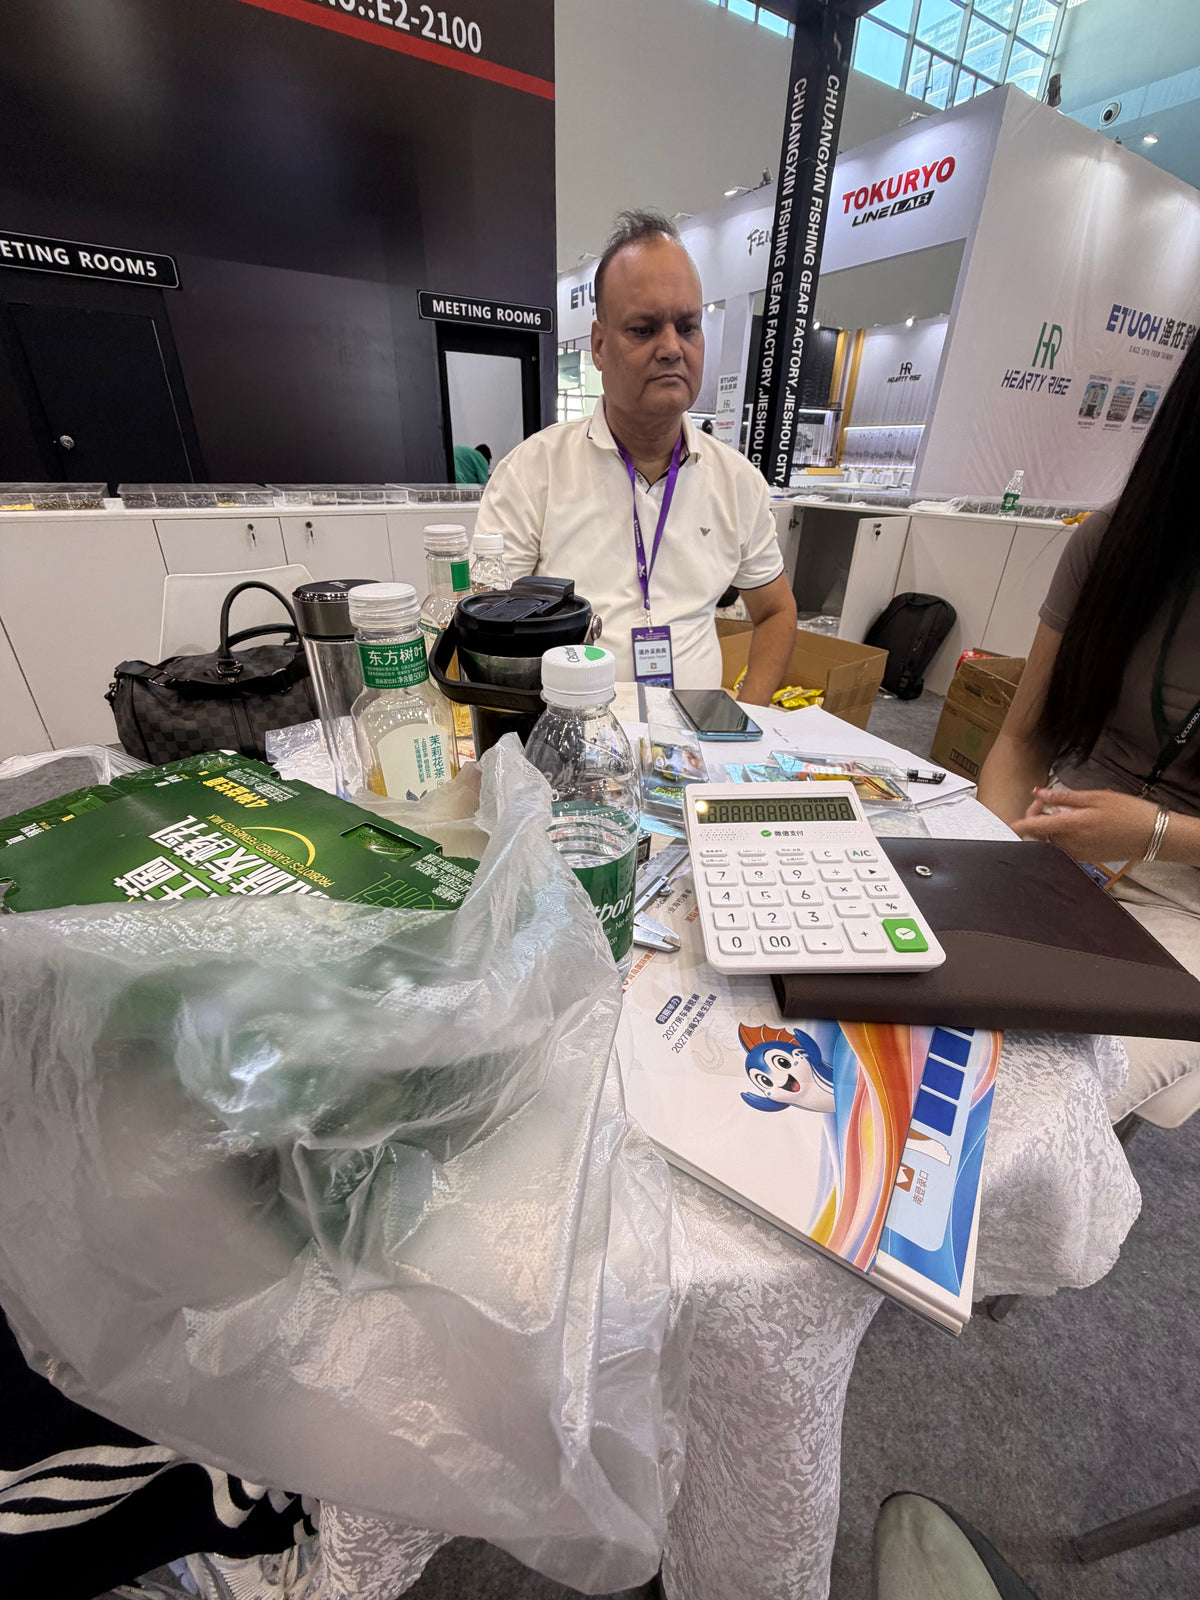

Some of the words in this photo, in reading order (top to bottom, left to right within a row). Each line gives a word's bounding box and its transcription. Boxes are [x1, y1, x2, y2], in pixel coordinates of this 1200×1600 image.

[782, 78, 807, 196] CHUANGXIN
[813, 74, 840, 193] CHUANGXIN
[842, 156, 956, 214] TOKURYO
[852, 205, 891, 227] LINE
[891, 192, 931, 215] LAB
[774, 198, 792, 268] FISHING
[804, 197, 822, 266] FISHING
[78, 251, 158, 277] ROOM5
[768, 272, 784, 316] GEAR
[796, 270, 812, 314] GEAR
[432, 300, 492, 319] MEETING
[496, 308, 542, 326] ROOM6
[1106, 304, 1163, 342] ETUOH
[1000, 369, 1047, 392] HEARTY
[1048, 378, 1072, 396] RISE
[368, 644, 423, 666] 东方树叶
[429, 734, 445, 778] 茉莉花茶
[206, 814, 225, 826] MILK
[220, 822, 257, 847] FERMENTED
[148, 815, 330, 898] 味发酵乳
[255, 844, 292, 866] FLAVORED
[113, 856, 220, 900] 生菌
[289, 860, 336, 888] PROBIOTICS
[717, 871, 726, 880] 7
[754, 870, 764, 880] 8
[792, 869, 802, 879] 9
[874, 884, 888, 892] GT
[721, 890, 731, 901] 4
[801, 890, 811, 900] 6
[728, 912, 735, 924] 1
[766, 912, 778, 923] 2
[808, 911, 820, 923] 3
[732, 936, 742, 949] 0
[769, 935, 792, 948] 00
[913, 1170, 929, 1206] 南登录口
